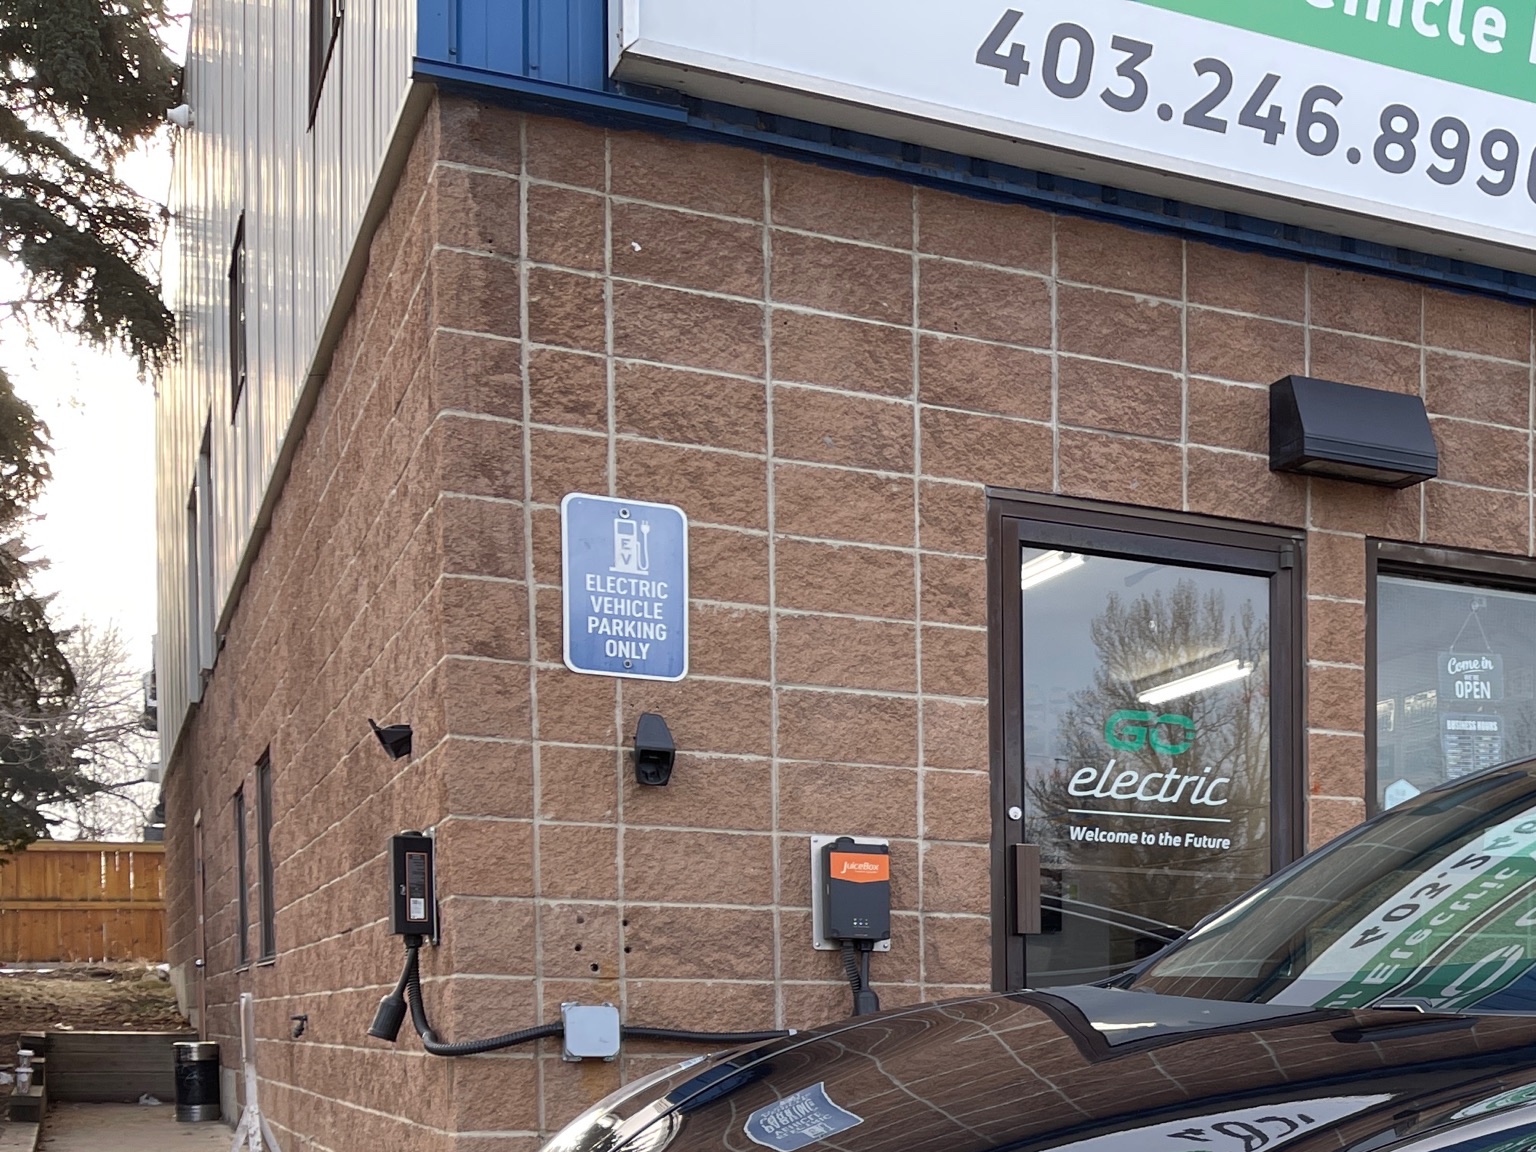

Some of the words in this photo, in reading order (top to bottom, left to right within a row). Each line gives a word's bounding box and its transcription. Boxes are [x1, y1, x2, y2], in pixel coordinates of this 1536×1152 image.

[585, 573, 668, 599] ELECTRIC
[590, 595, 663, 620] VEHICLE
[587, 616, 667, 641] PARKING
[605, 639, 650, 660] ONLY
[1447, 657, 1480, 675] Come
[1481, 656, 1494, 670] in
[1455, 680, 1491, 699] OPEN
[1067, 759, 1230, 807] electric
[1069, 826, 1137, 846] Welcome
[1141, 830, 1156, 846] to
[1158, 830, 1182, 848] the
[1184, 832, 1231, 850] Future
[840, 860, 880, 874] JuiceBox
